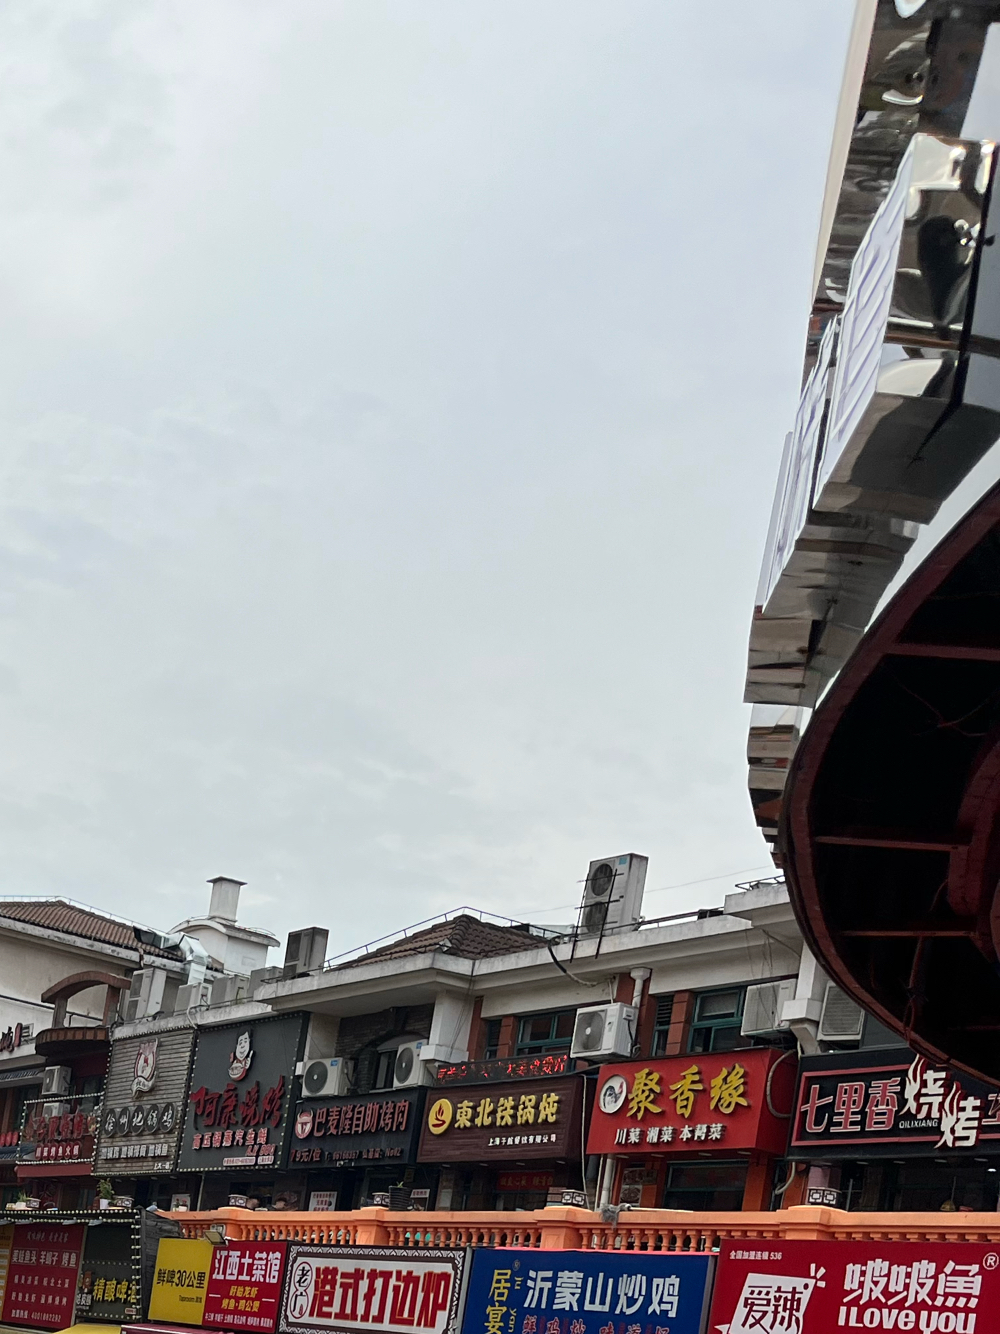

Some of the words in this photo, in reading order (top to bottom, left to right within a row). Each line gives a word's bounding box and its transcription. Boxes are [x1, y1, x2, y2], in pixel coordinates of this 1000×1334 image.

[626, 1063, 749, 1121] 聚香缘
[801, 1077, 901, 1133] 七里香
[900, 1053, 981, 1149] 烧烤
[104, 1105, 174, 1132] 徐州地锅鸡
[313, 1099, 410, 1137] 巴麦隆自助烤肉
[454, 1092, 559, 1129] 東北铁锅炖
[899, 1119, 938, 1129] QILIXIANG
[192, 1127, 268, 1150] 高压锅蒸汽生蚝
[614, 1128, 642, 1145] 川菜
[646, 1126, 675, 1143] 湘菜
[679, 1123, 724, 1141] 本帮菜
[212, 1250, 282, 1283] 江西土菜馆
[769, 1252, 783, 1261] 536
[156, 1268, 206, 1290] 鲜啤30公里
[523, 1269, 682, 1319] 沂蒙山炒鸡
[308, 1265, 452, 1329] 港式打边炉
